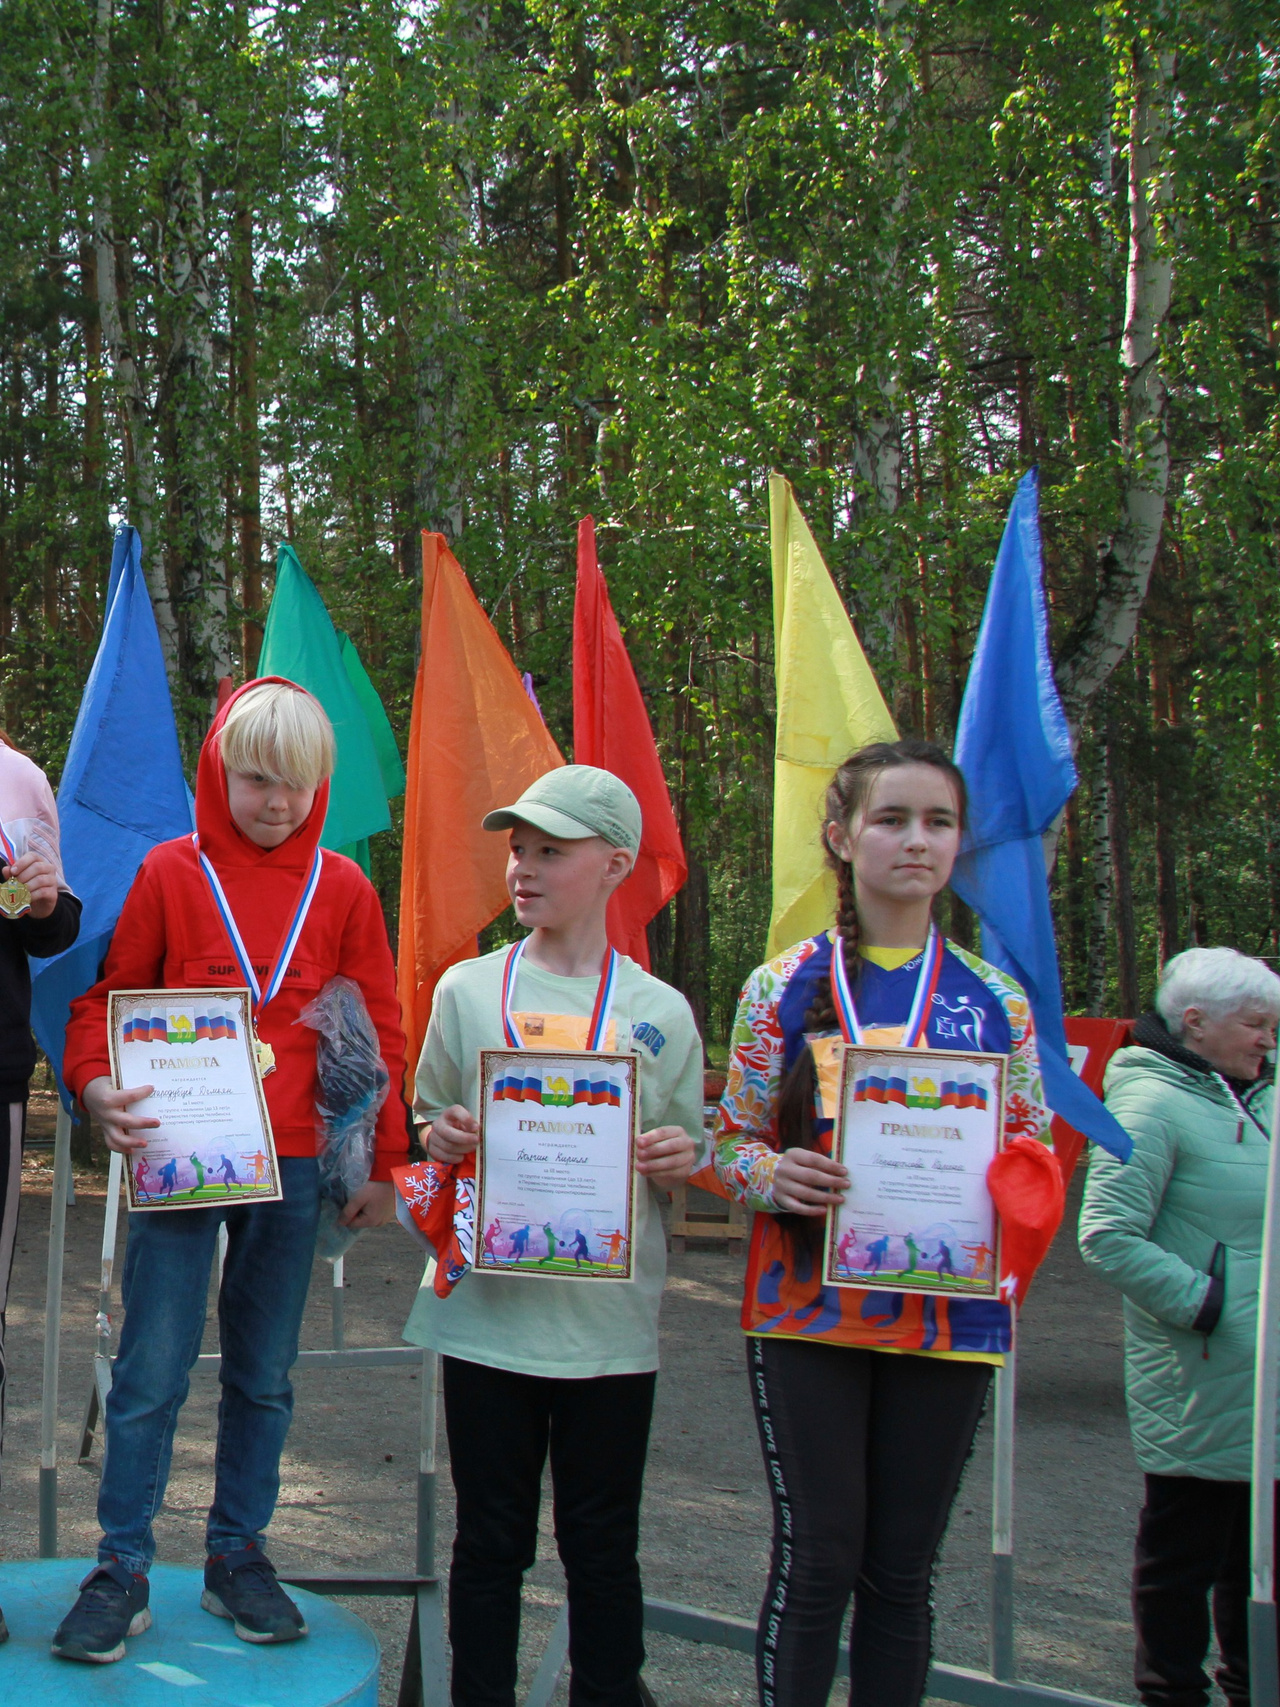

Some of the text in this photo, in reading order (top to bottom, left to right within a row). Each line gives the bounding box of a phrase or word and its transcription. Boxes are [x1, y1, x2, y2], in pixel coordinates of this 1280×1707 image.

[9, 893, 16, 904] 1
[207, 965, 302, 979] SUPVION
[150, 1057, 219, 1069] ГРАМОТА
[518, 1120, 595, 1135] ГРАМОТА
[880, 1123, 962, 1140] ГРАМОТА
[555, 1152, 588, 1165] Кирилл
[754, 1337, 763, 1365] OVE
[756, 1372, 769, 1409] LOVE
[762, 1415, 778, 1454] LOVE
[770, 1459, 788, 1497] LOVE
[780, 1501, 792, 1539] LOVE
[780, 1542, 792, 1580] LOVE
[765, 1613, 782, 1650] LOVE
[763, 1651, 775, 1687] LOVE
[763, 1689, 775, 1707] LO
